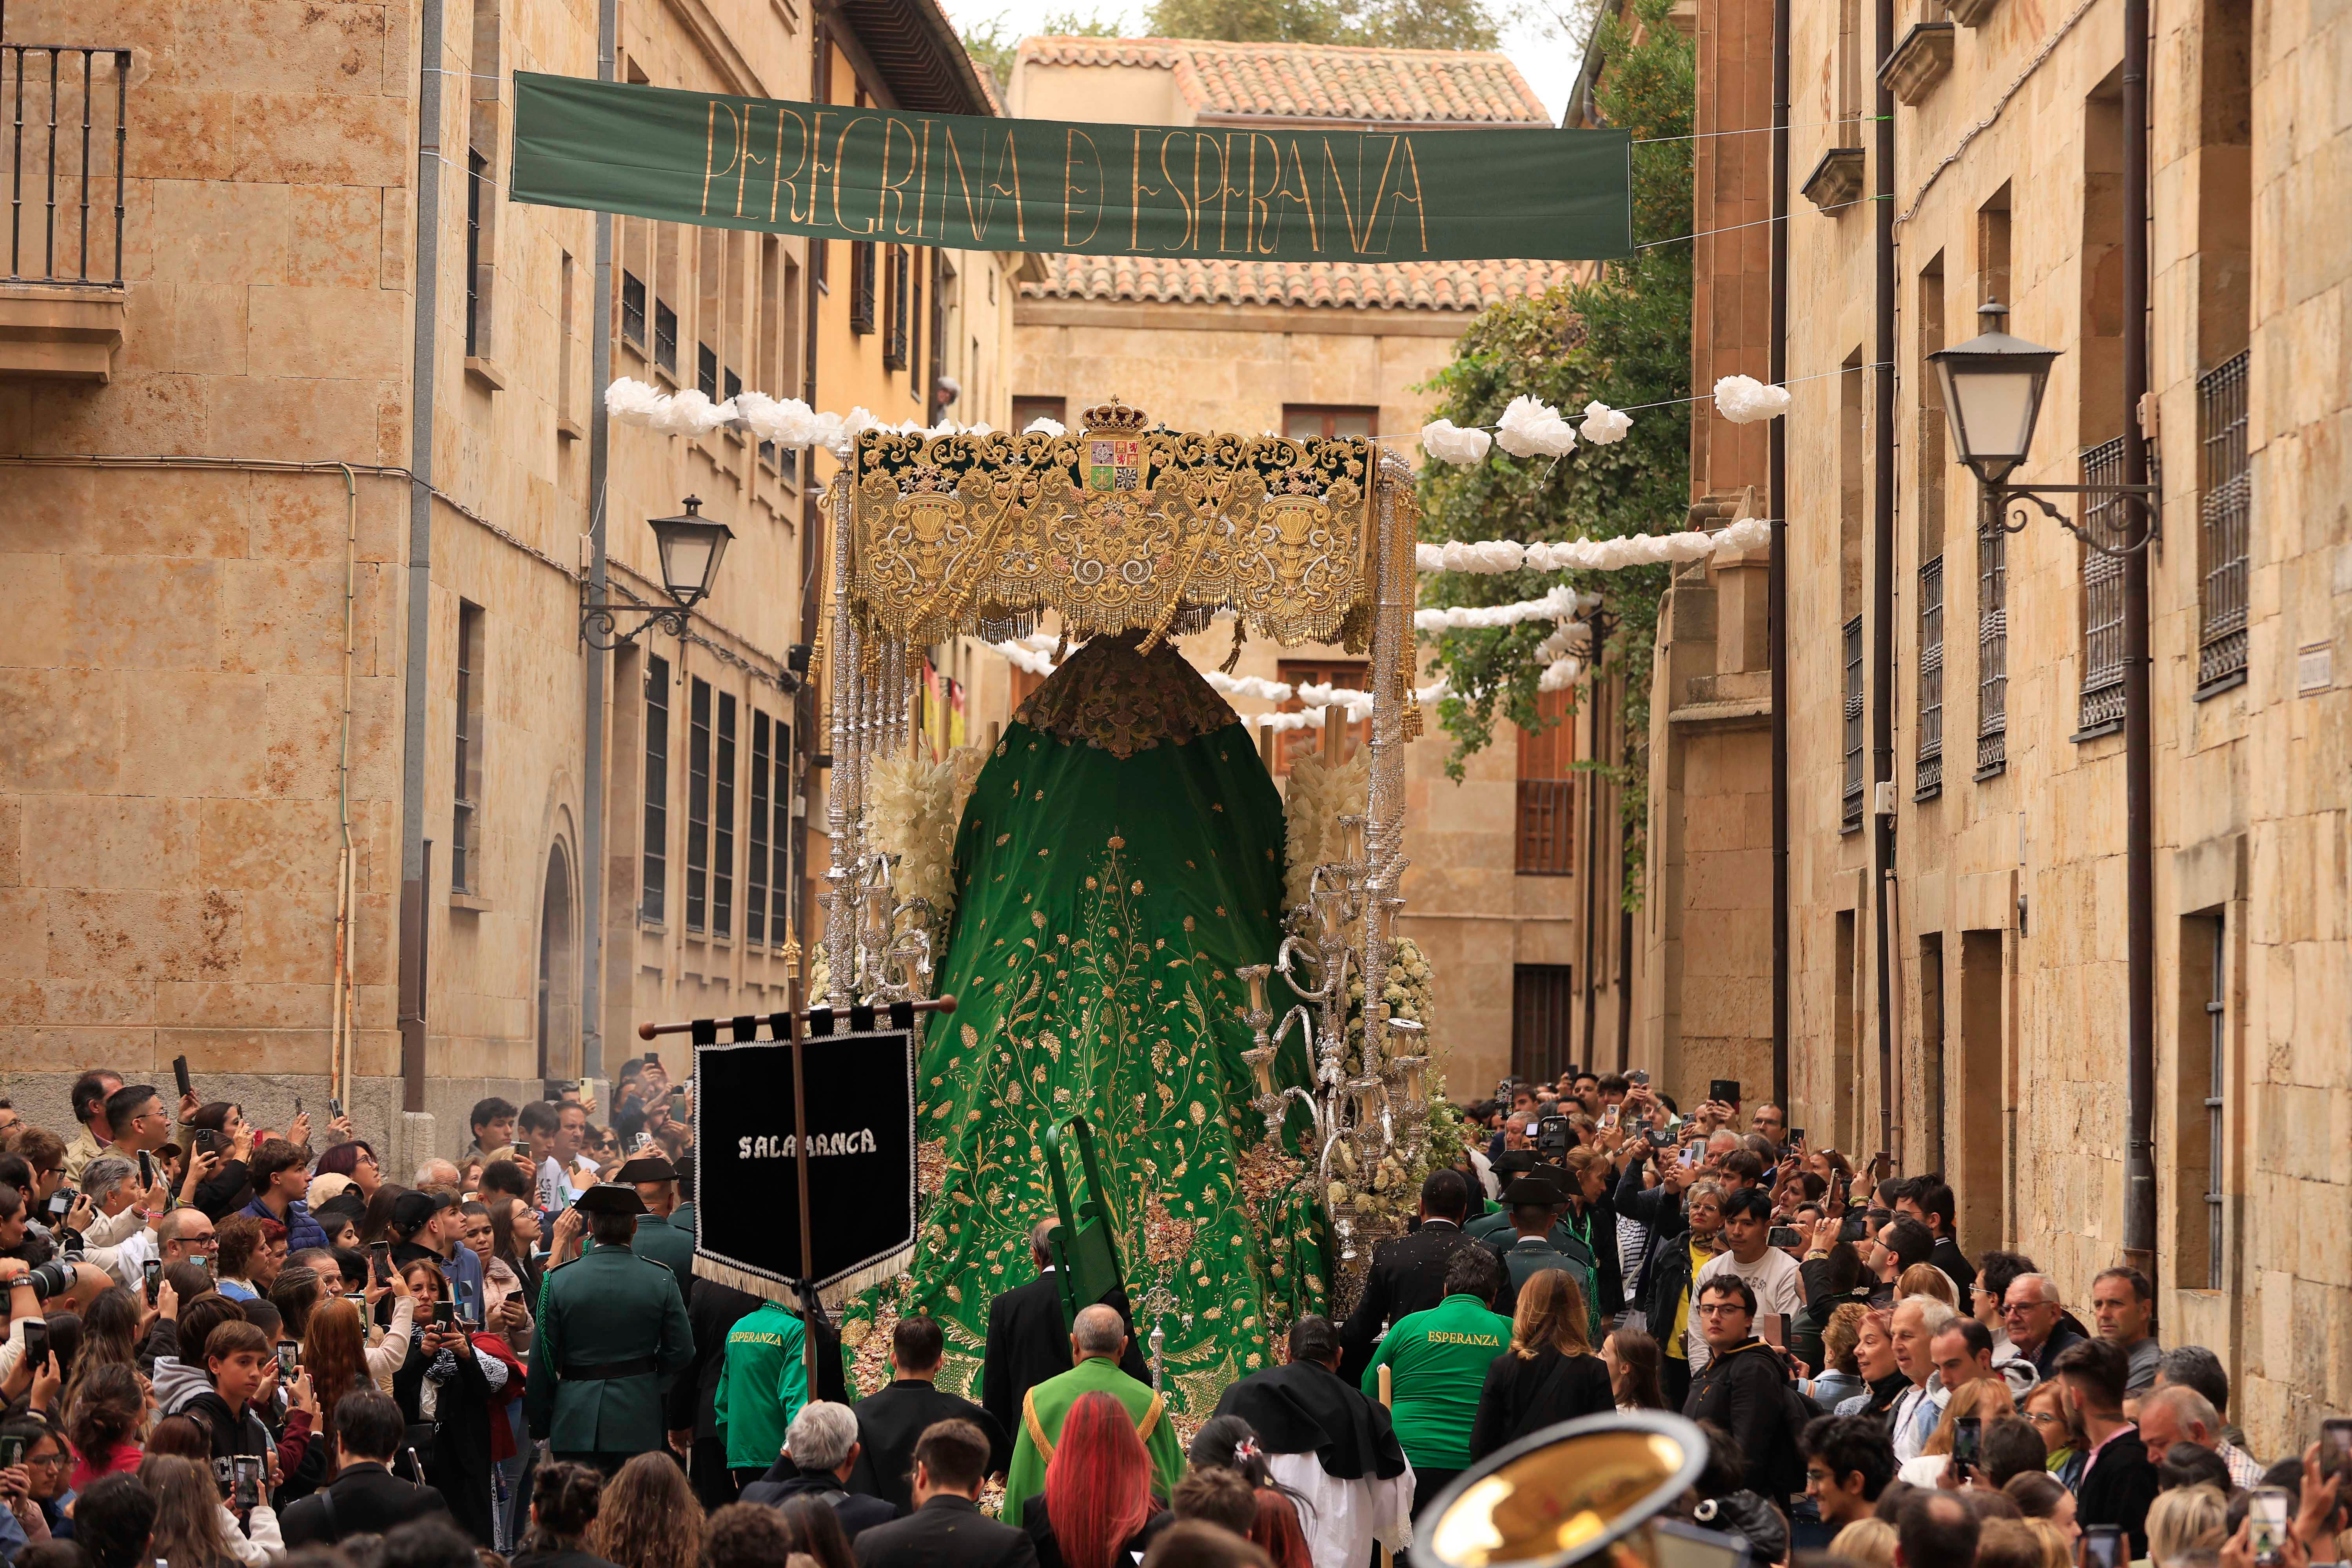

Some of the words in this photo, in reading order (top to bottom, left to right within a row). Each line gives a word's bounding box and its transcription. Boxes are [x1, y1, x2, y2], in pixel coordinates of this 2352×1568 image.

[700, 100, 1027, 242] PEREGRINA
[1125, 129, 1428, 254] ESPERANZA
[729, 1332, 781, 1346] ESPERANZA
[1428, 1331, 1500, 1347] ESPERANZA
